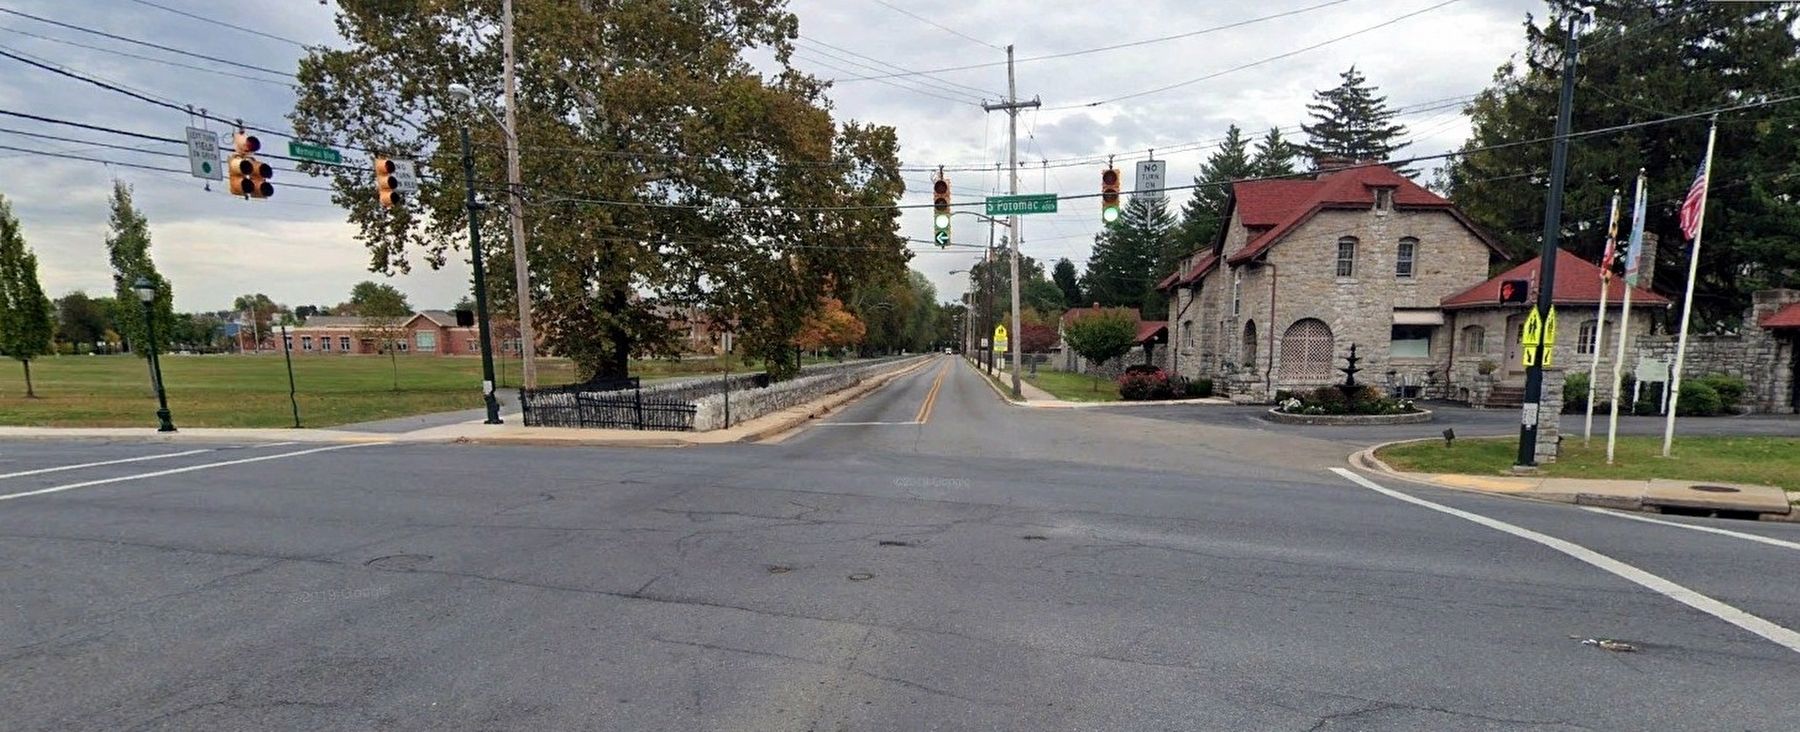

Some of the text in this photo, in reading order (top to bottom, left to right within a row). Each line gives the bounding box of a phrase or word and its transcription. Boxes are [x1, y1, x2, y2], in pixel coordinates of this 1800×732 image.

[195, 141, 214, 151] YIELD
[294, 145, 323, 158] Memorial
[1144, 164, 1157, 172] NO
[988, 200, 994, 211] S
[997, 200, 1038, 211] Potomac
